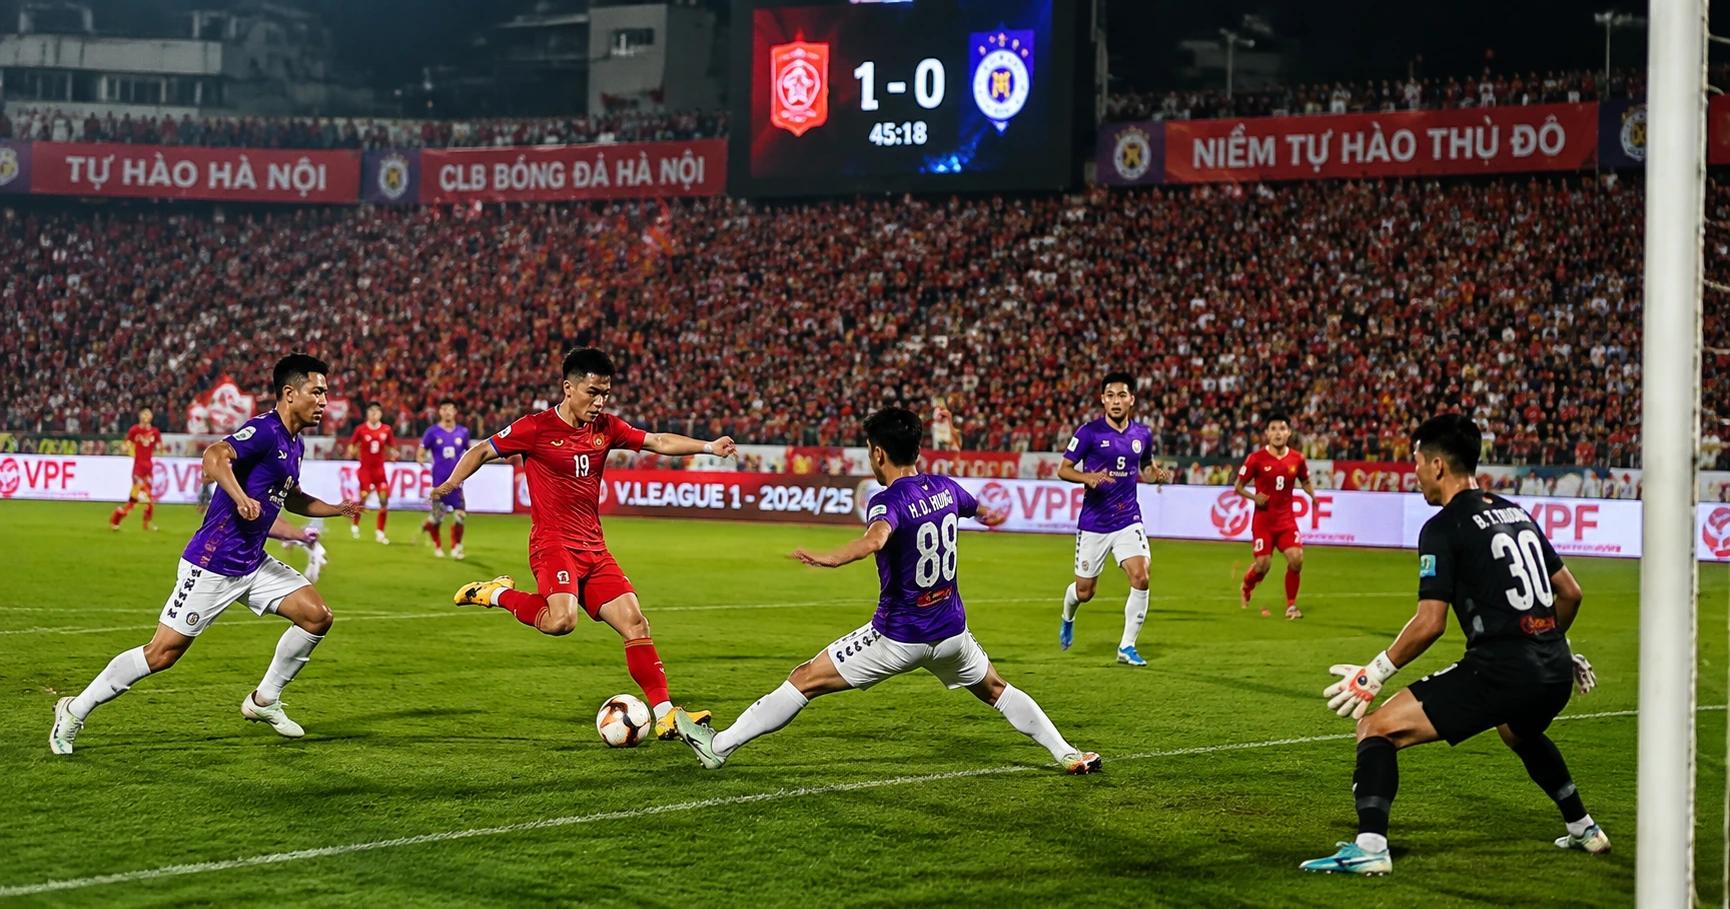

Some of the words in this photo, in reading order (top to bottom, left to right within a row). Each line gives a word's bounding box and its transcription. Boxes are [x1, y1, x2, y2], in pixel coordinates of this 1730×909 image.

[869, 121, 927, 145] 45:18
[1193, 122, 1276, 169] NIỀM
[1286, 128, 1334, 173] TỰ
[1341, 121, 1417, 164] HÀO
[1510, 114, 1566, 157] ĐÔ
[65, 153, 115, 191] TỰ
[123, 147, 199, 188] HÀO
[208, 154, 257, 190] HÀ
[267, 156, 327, 199] NỘI
[440, 164, 487, 191] CLB
[493, 153, 566, 190] BÓNG
[616, 150, 653, 187] HÀ
[659, 148, 705, 191] NỘI
[24, 461, 76, 489] VPF
[173, 463, 203, 493] VP
[573, 454, 590, 478] 19
[1275, 475, 1285, 491] 8
[614, 480, 726, 509] V.LEAGUE
[728, 484, 742, 509] 1
[758, 484, 854, 515] 2024/25
[1292, 495, 1333, 530] PF
[915, 512, 957, 588] 88
[1491, 529, 1554, 611] 30
